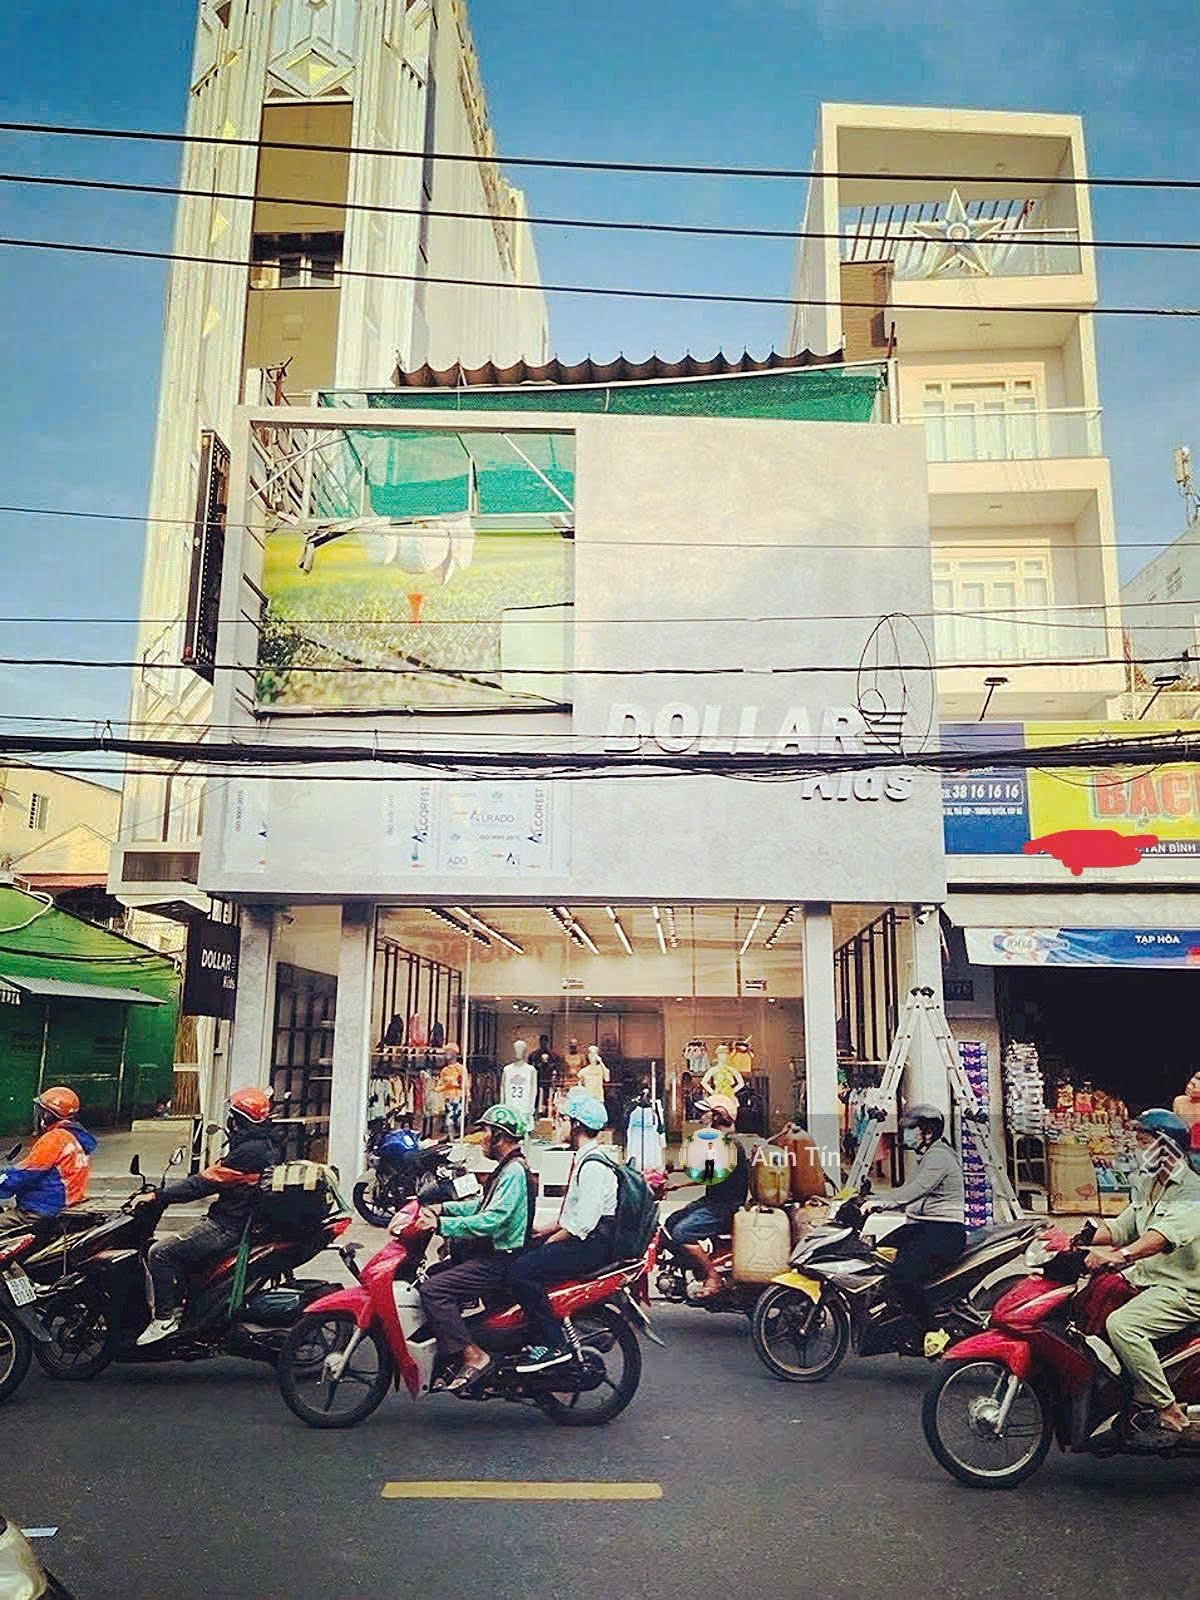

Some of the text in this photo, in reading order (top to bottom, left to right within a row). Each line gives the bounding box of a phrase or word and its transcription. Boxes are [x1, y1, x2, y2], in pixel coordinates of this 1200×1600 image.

[604, 702, 864, 755] DOLLAR
[971, 783, 985, 799] 16
[988, 783, 1002, 799] 16
[1005, 783, 1019, 799] 16
[1091, 770, 1200, 819] BAC
[1169, 841, 1196, 853] BÌNH
[1134, 935, 1156, 946] TẠP
[201, 948, 232, 971] DOLLAR
[511, 1086, 523, 1098] 23
